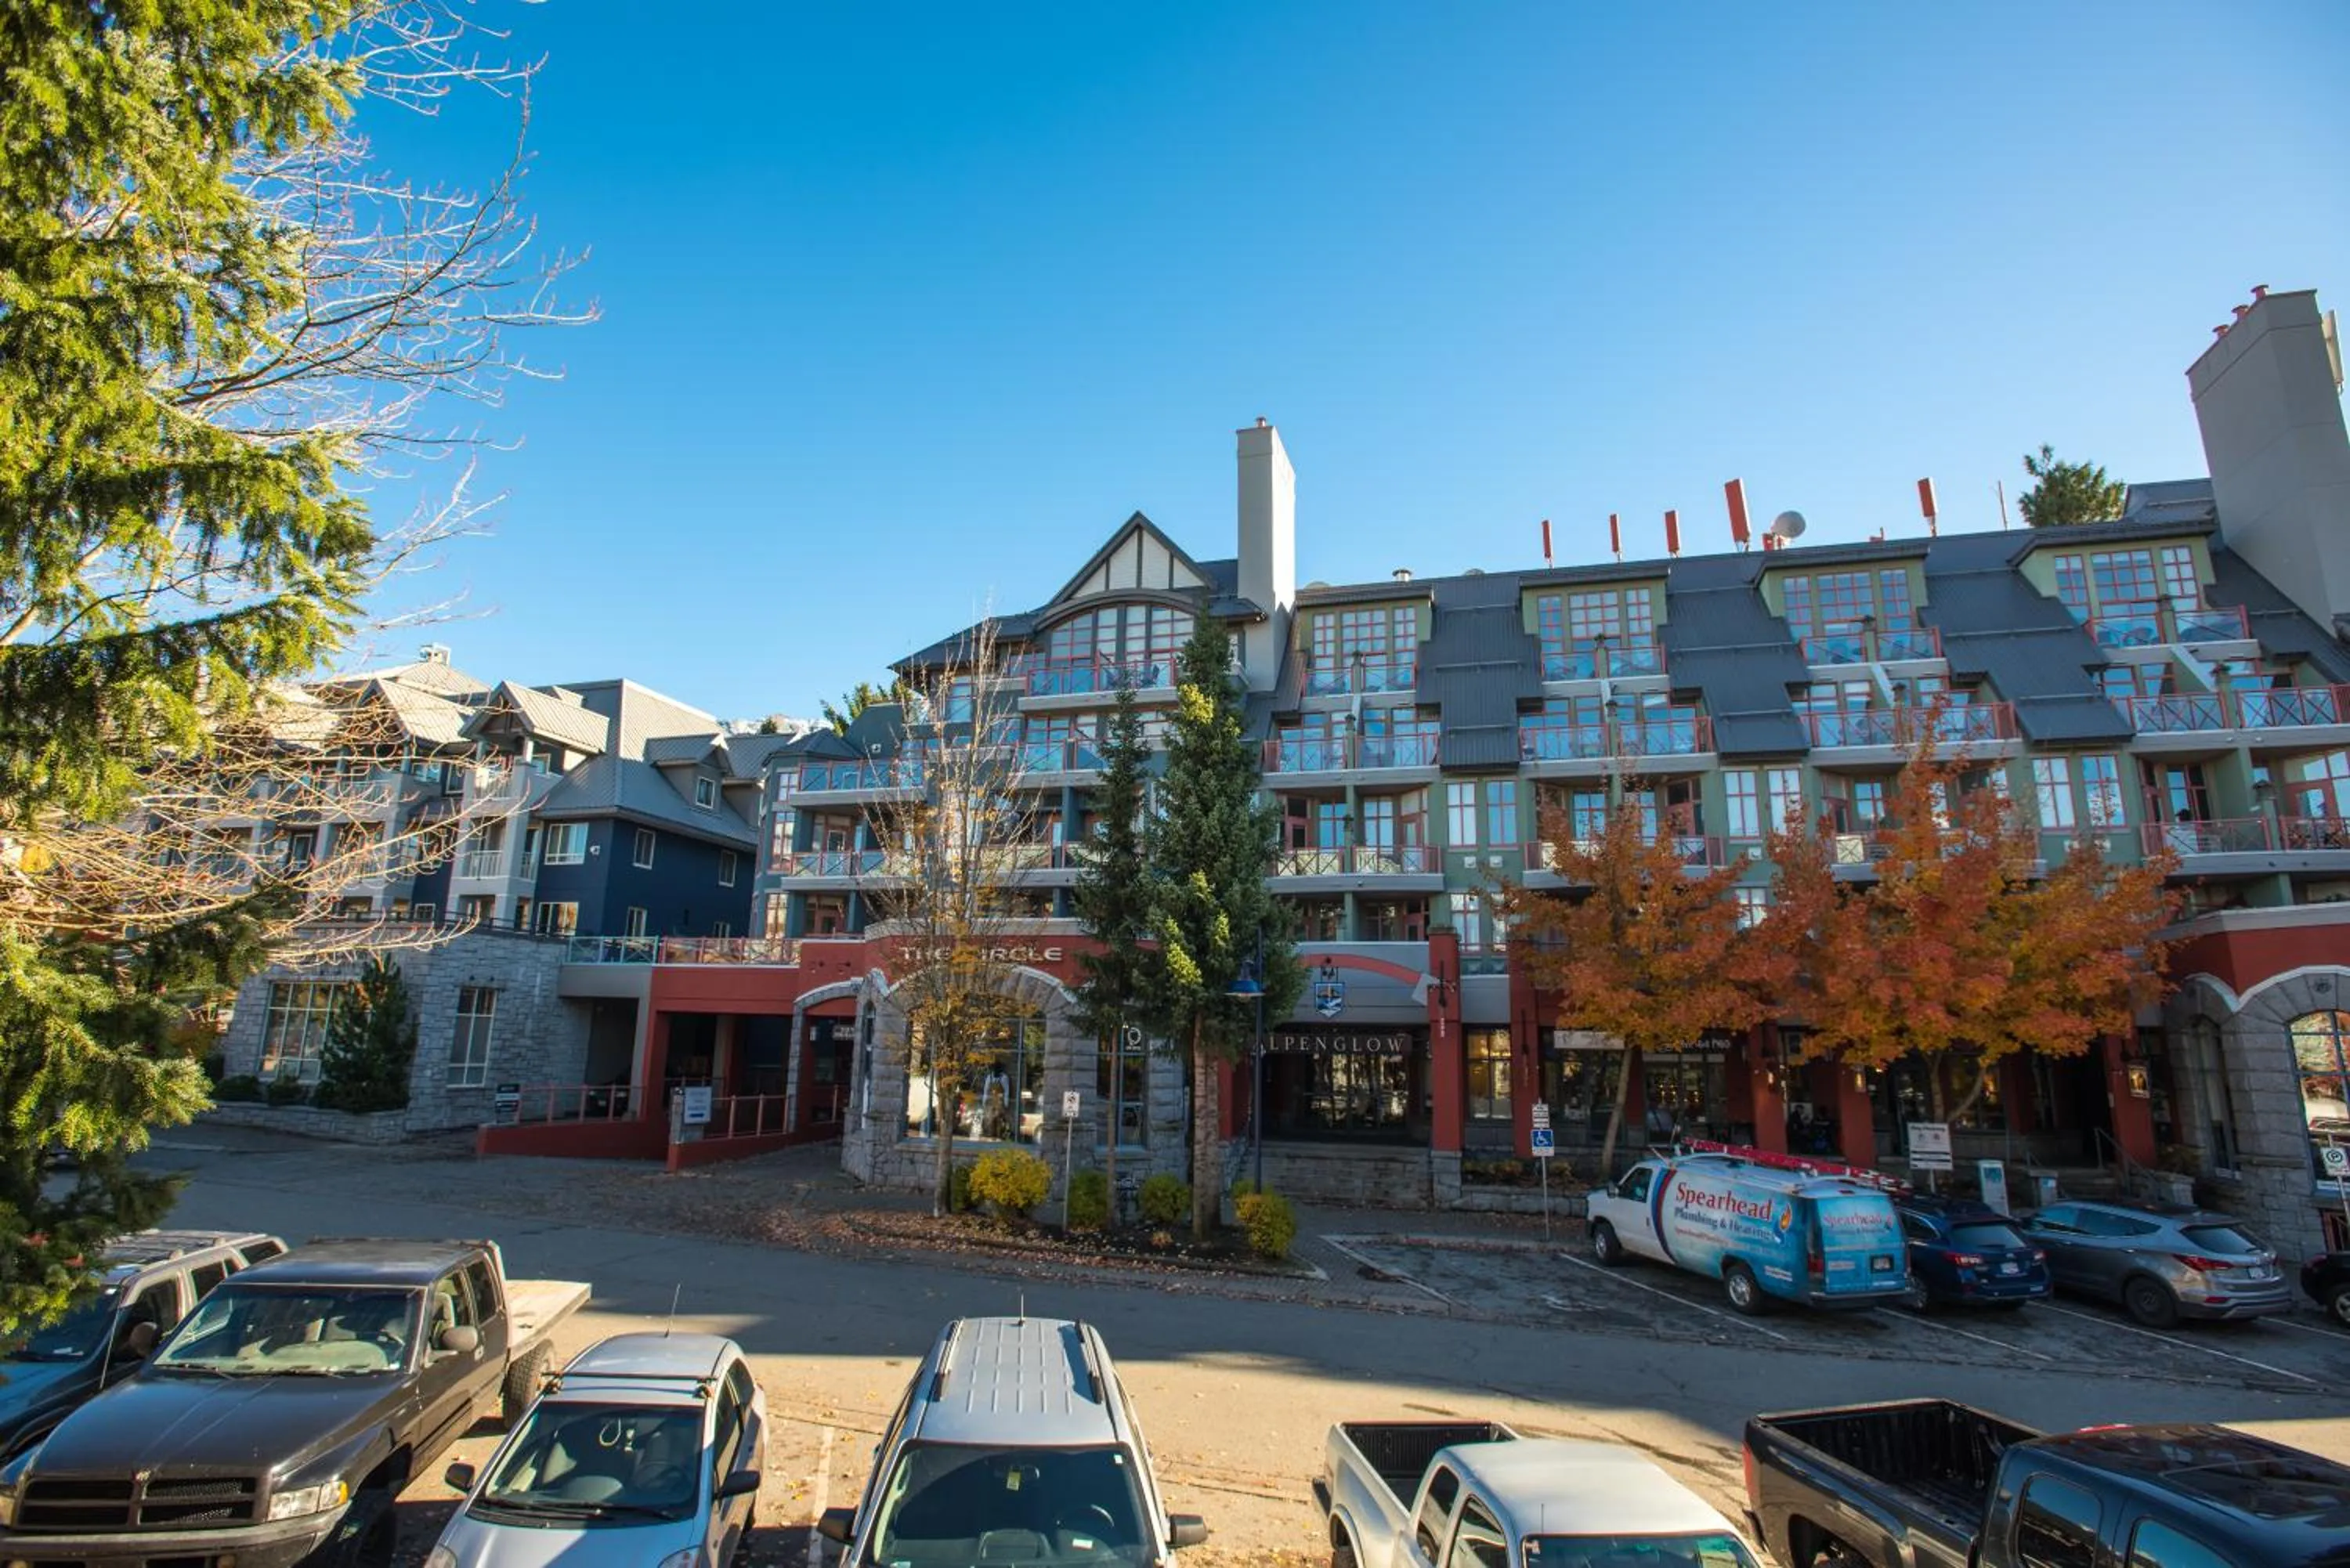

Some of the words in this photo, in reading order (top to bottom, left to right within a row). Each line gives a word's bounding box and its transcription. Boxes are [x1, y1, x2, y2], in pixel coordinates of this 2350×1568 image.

[955, 946, 1063, 962] IRCLE
[1256, 1035, 1405, 1052] LPENGLOW
[1676, 1181, 1773, 1222] Spearhead
[1674, 1207, 1718, 1230] Plumbing
[1719, 1218, 1727, 1230] &
